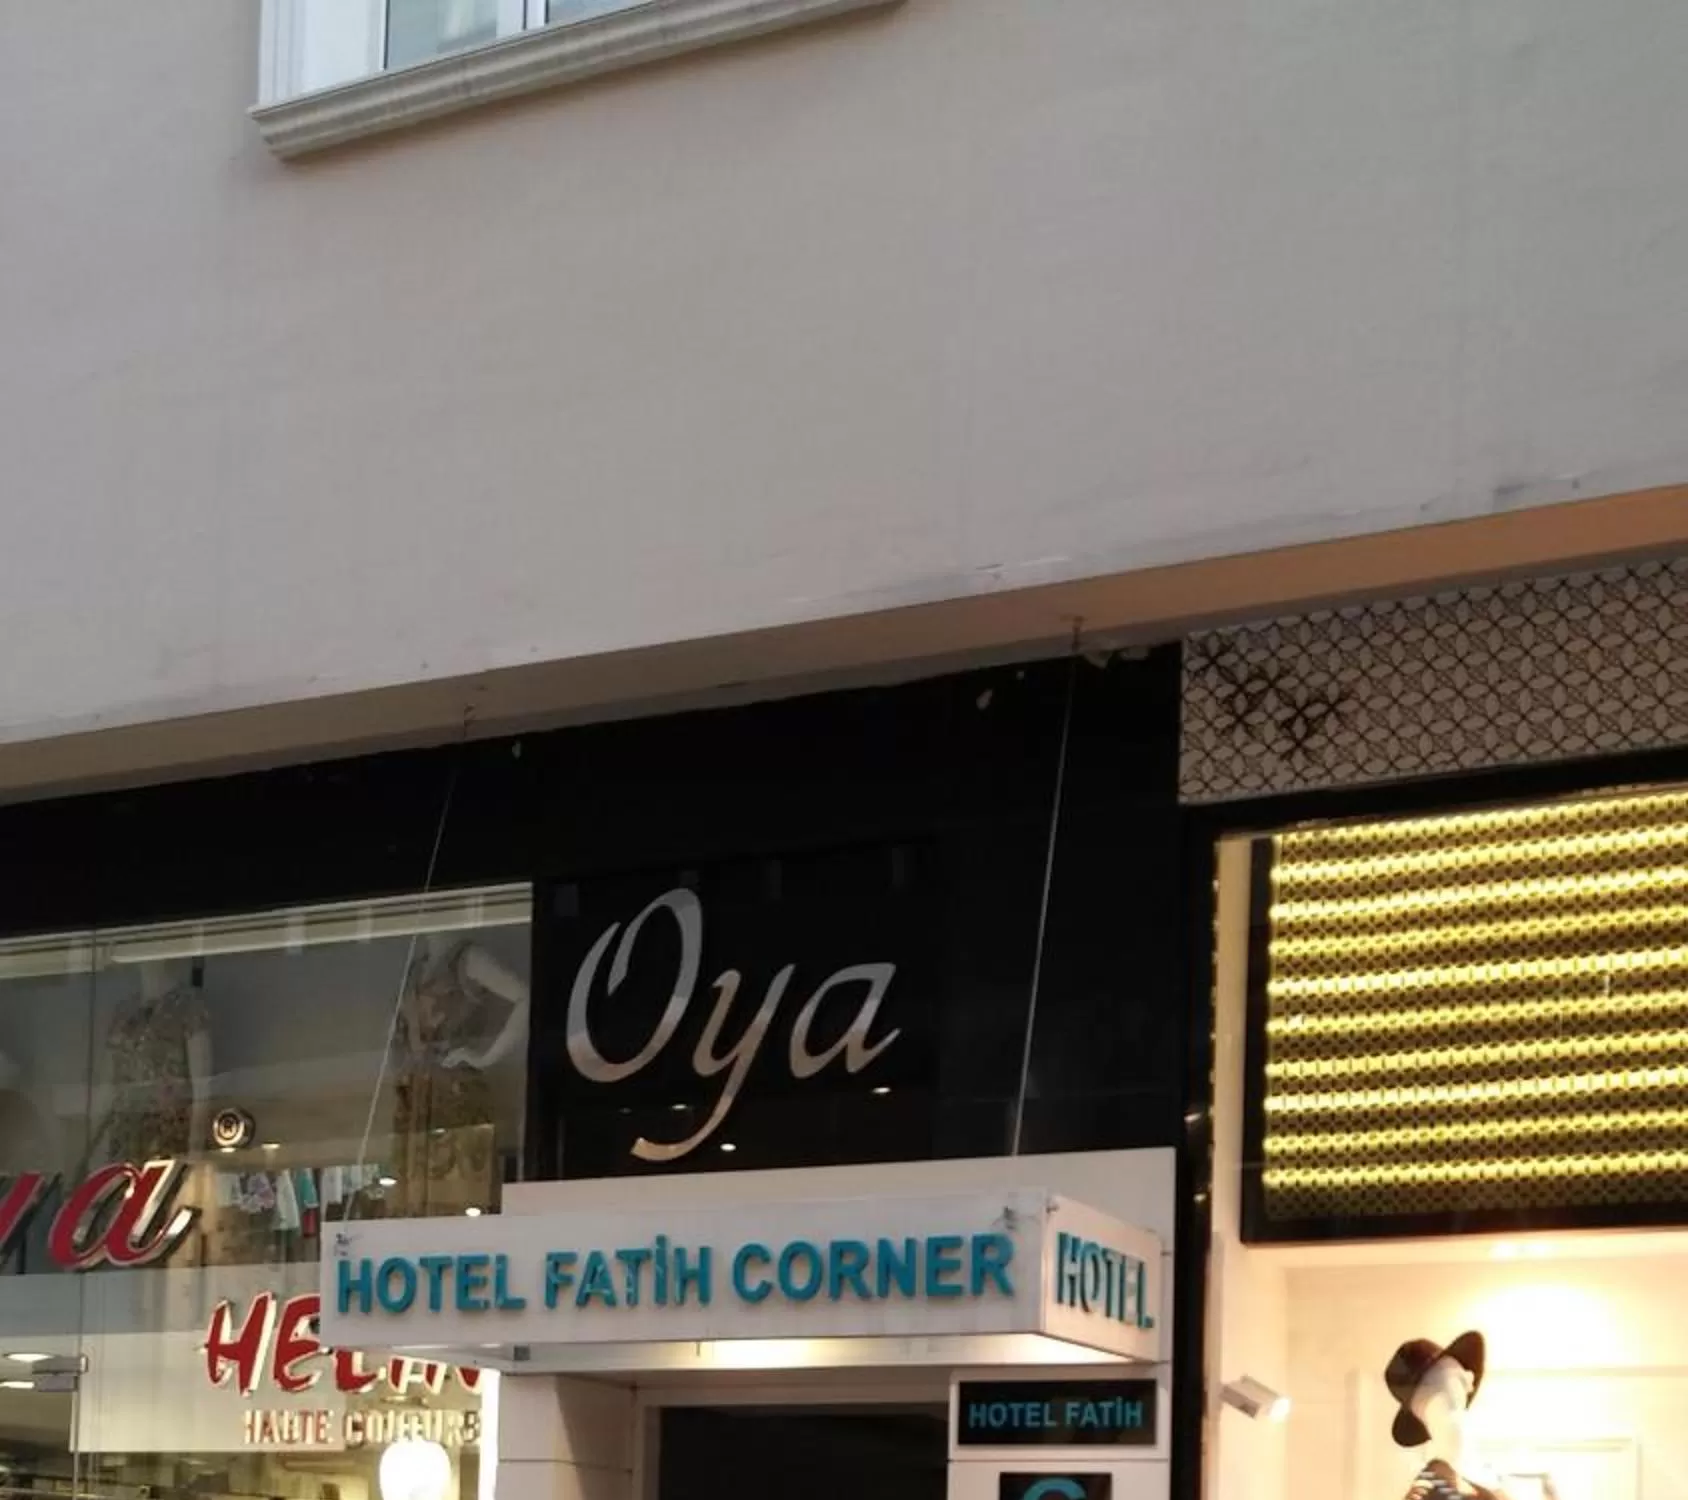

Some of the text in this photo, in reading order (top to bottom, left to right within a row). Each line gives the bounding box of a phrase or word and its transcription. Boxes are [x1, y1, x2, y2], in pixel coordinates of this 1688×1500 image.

[566, 887, 902, 1162] Oya
[336, 1232, 1017, 1316] HOTEL FATİH CORNER
[1055, 1231, 1155, 1331] HOTEL
[243, 1408, 335, 1446] HAUTE
[968, 1396, 1144, 1429] HOTEL FATİH
